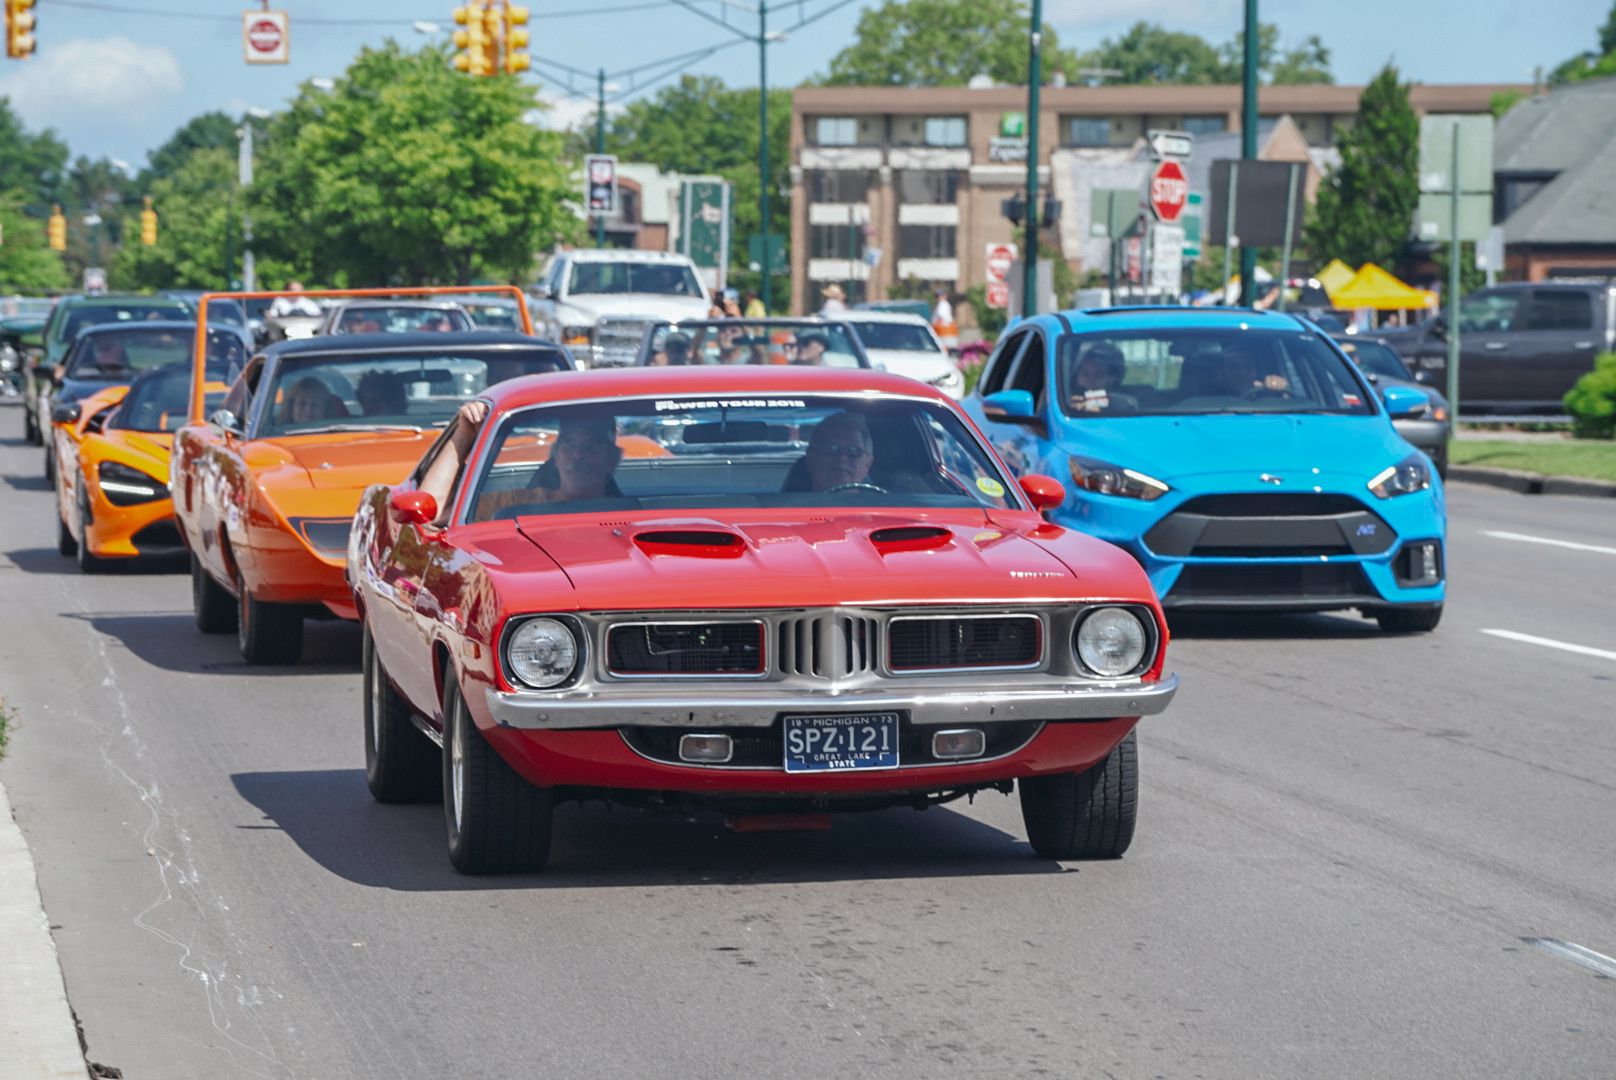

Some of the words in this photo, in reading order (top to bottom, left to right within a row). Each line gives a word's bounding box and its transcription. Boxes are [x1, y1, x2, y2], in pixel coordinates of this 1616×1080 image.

[1152, 177, 1186, 204] STOP
[719, 400, 766, 408] TOUR
[813, 716, 870, 726] MICHIGAN
[813, 753, 841, 762] GREAT
[828, 760, 856, 769] STATE
